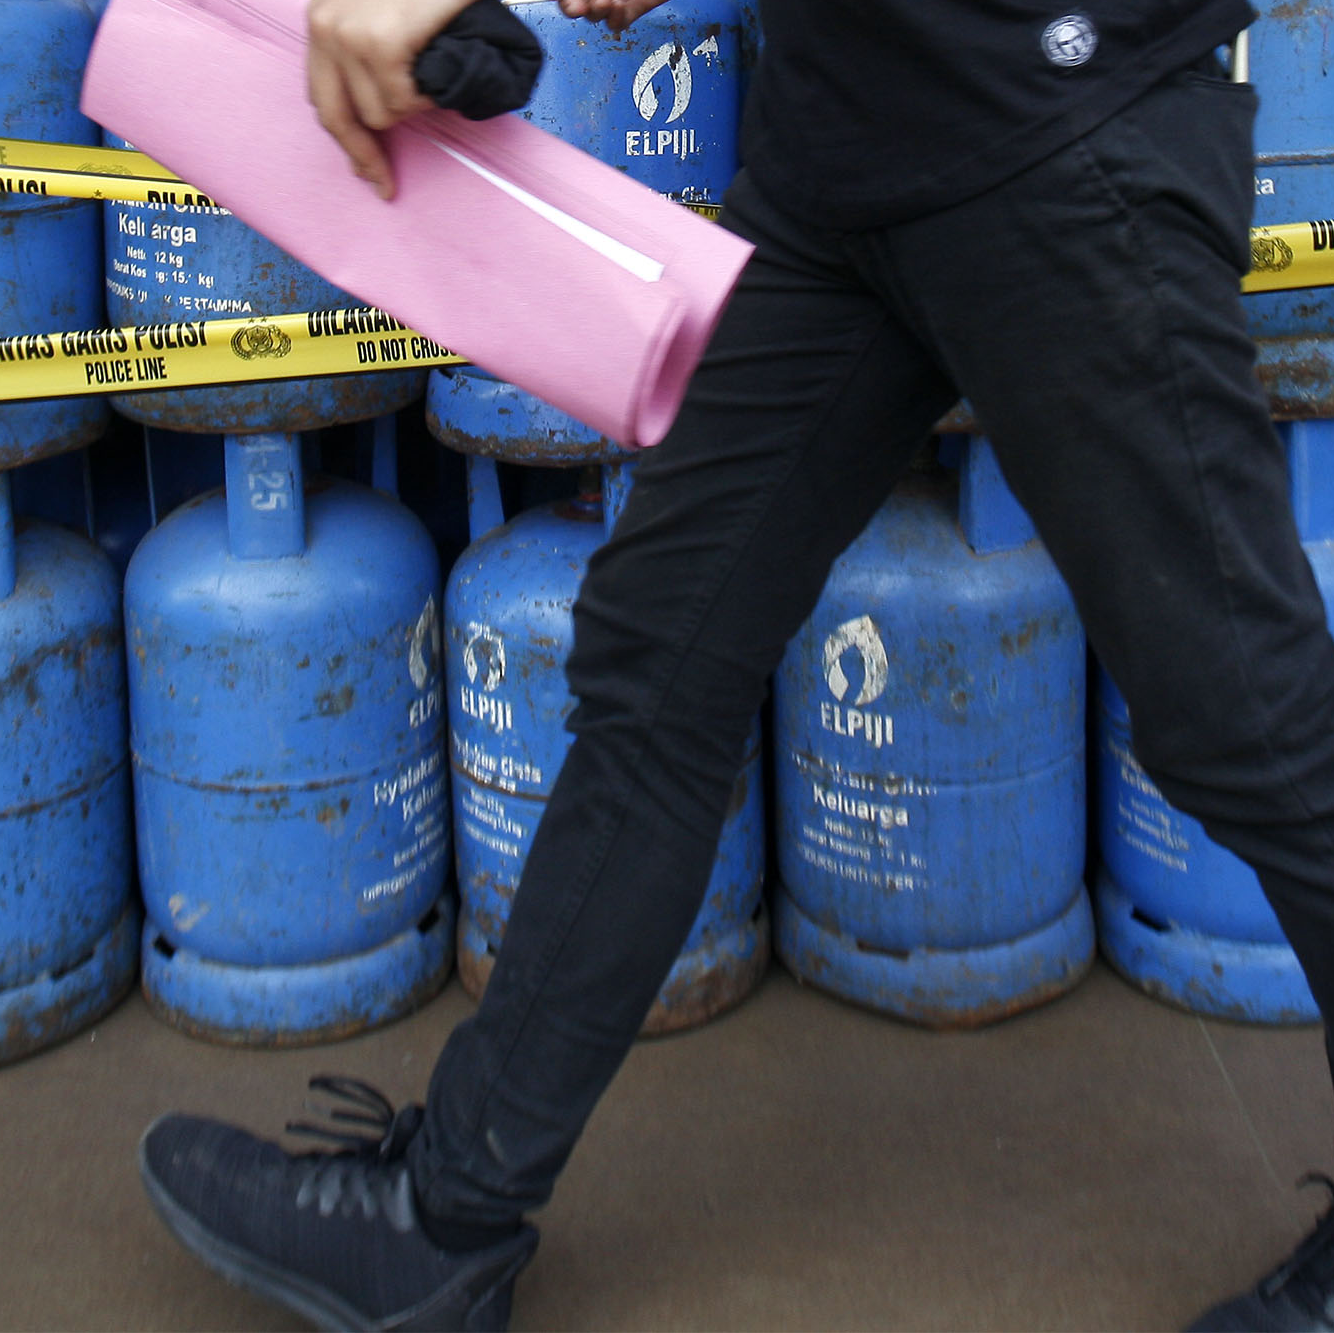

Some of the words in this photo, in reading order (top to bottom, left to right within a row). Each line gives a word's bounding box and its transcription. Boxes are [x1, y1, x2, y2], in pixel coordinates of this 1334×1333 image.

[625, 128, 696, 161] ELPIJI
[154, 251, 168, 264] 12
[169, 251, 184, 268] kg
[356, 340, 377, 364] DO
[380, 338, 407, 363] NOT
[85, 359, 134, 386] POLICE
[137, 356, 168, 382] LINE
[460, 684, 513, 735] ELPIJI
[820, 701, 895, 749] ELPIJI
[812, 782, 909, 830] Keluarga
